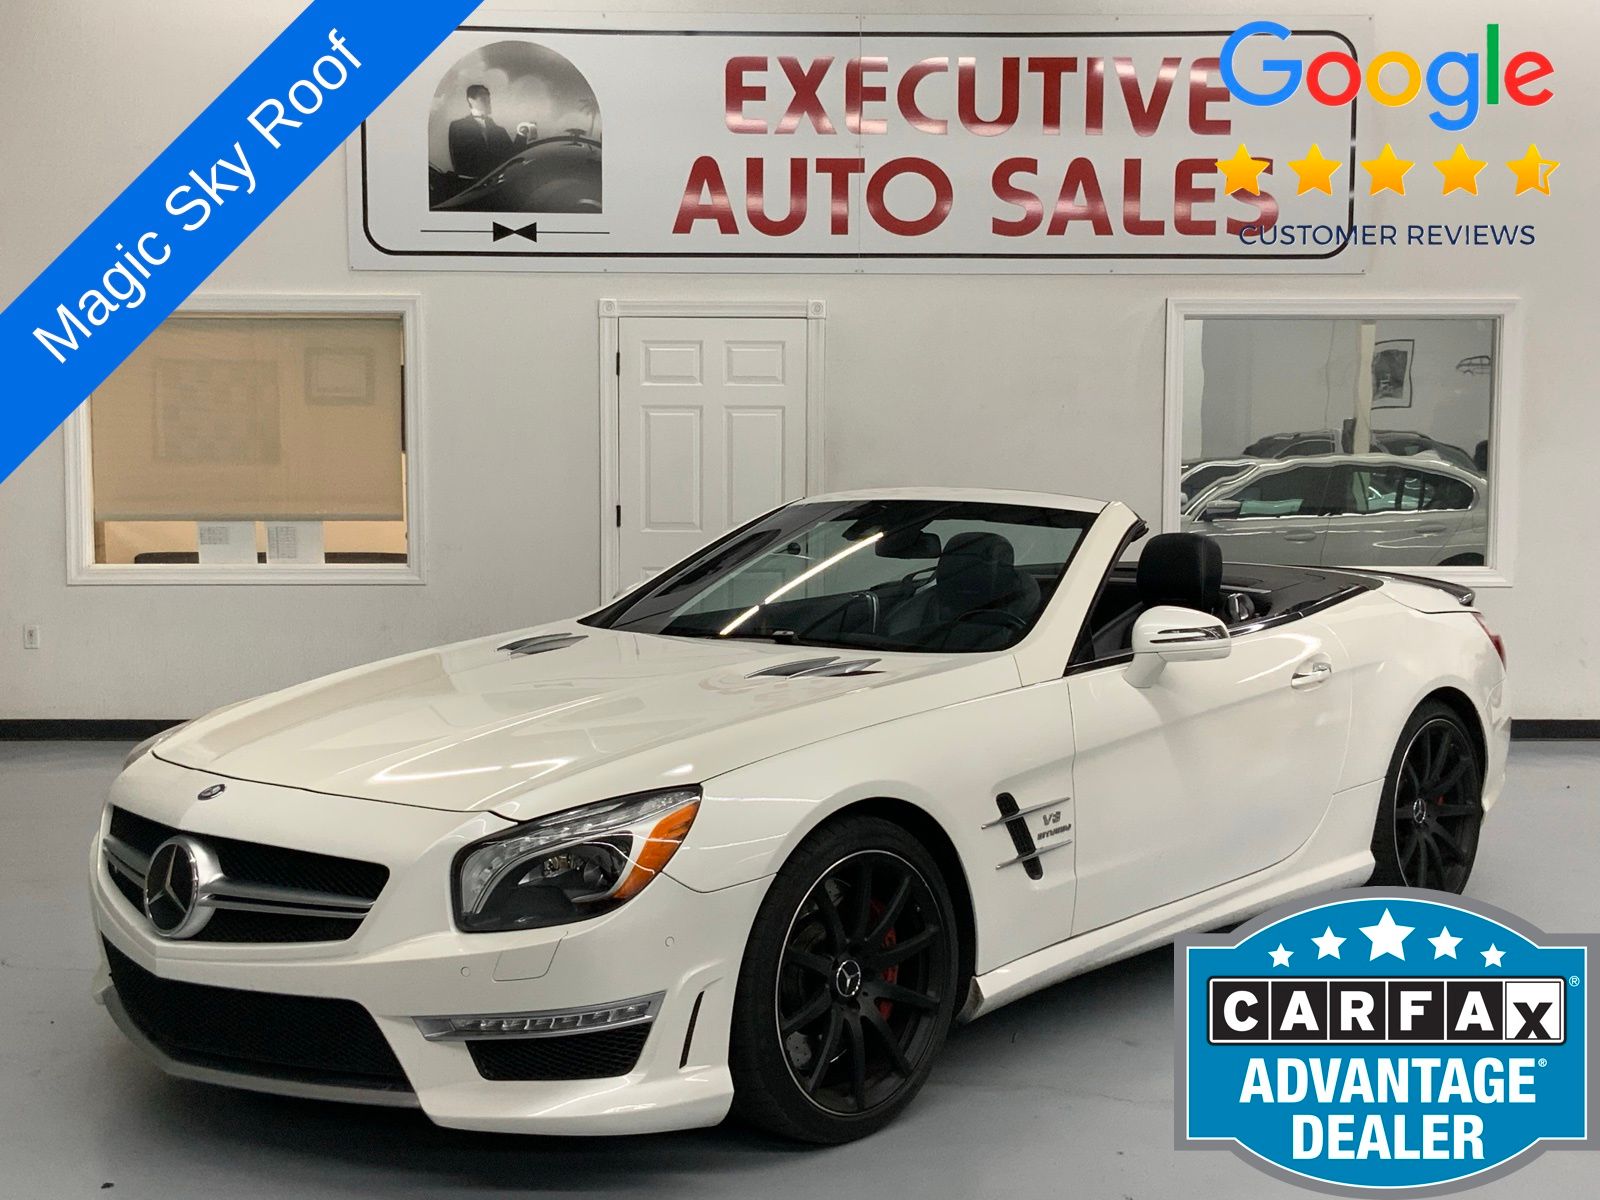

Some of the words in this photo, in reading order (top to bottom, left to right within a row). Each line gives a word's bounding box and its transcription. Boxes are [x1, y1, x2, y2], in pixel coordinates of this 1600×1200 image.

[724, 56, 1232, 137] EXECUTIVE
[672, 155, 954, 237] AUTO
[991, 156, 1279, 237] SALES
